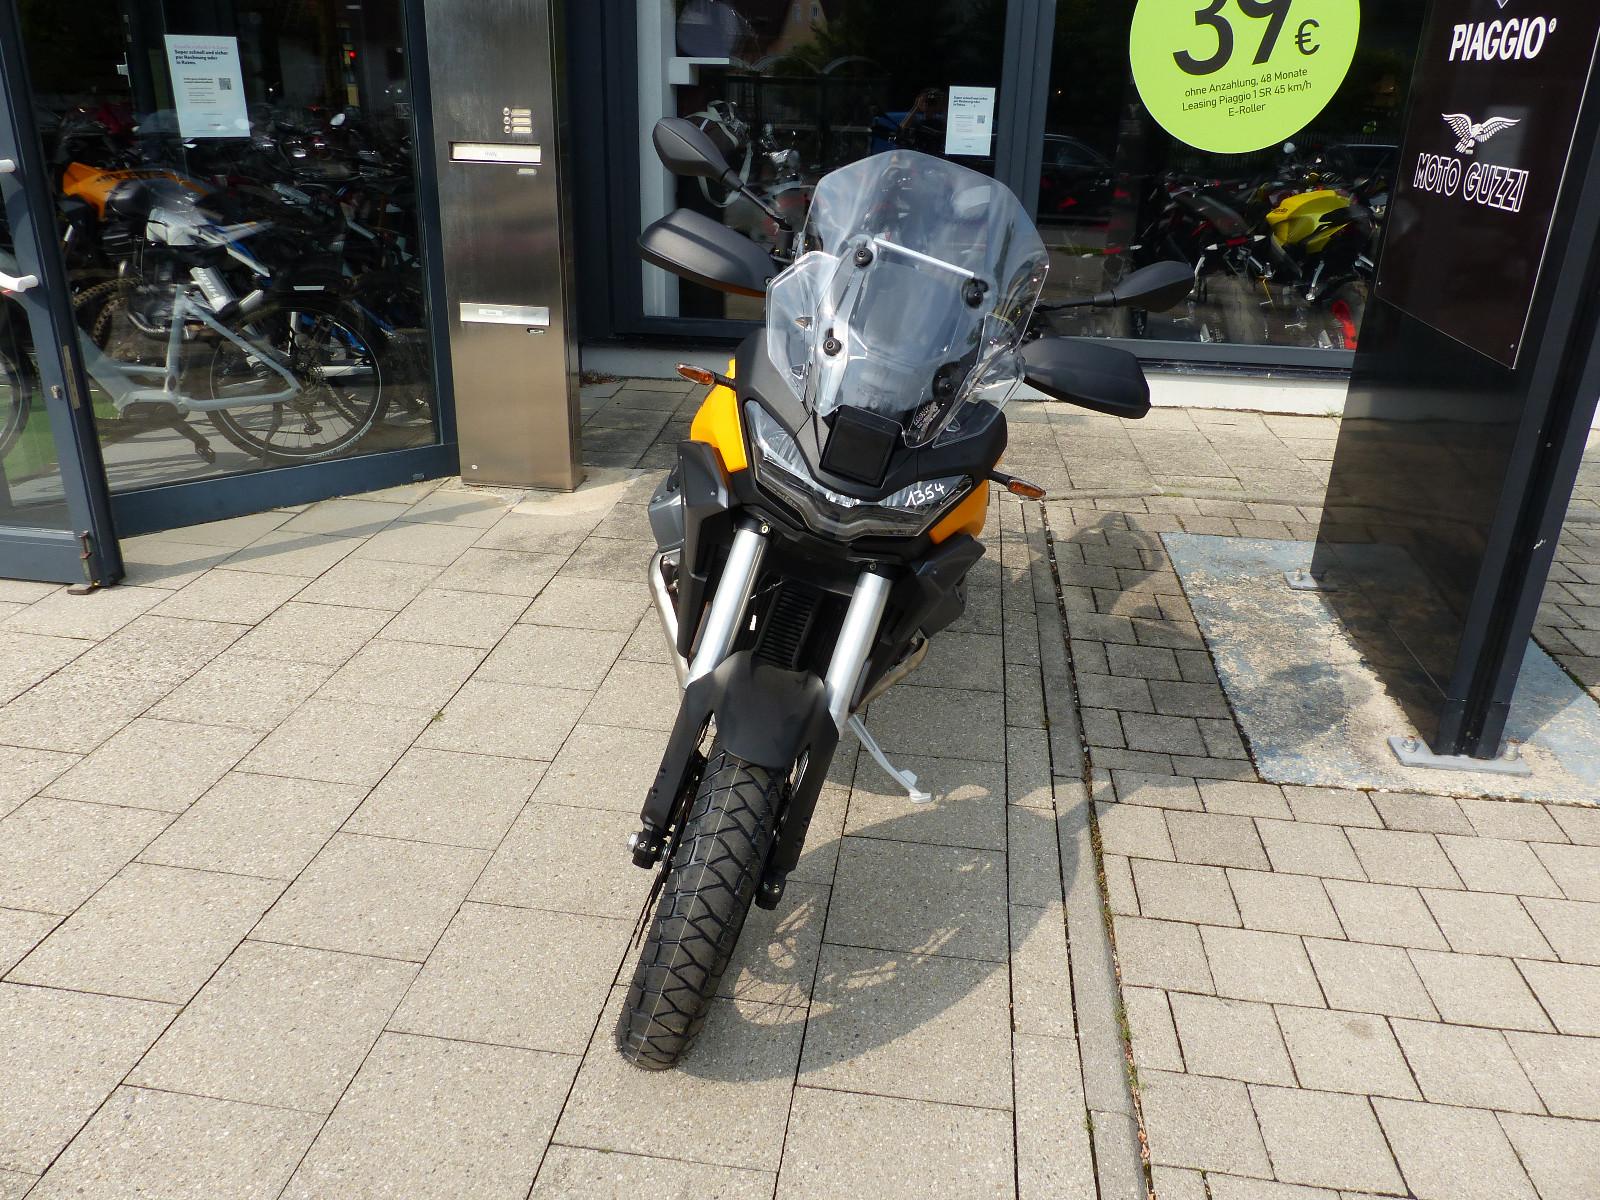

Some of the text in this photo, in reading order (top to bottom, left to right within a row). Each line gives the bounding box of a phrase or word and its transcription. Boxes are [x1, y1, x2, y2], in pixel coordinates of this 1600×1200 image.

[1172, 0, 1292, 75] 39
[1182, 79, 1312, 111] Leasing Piaggio 1 SR 45 km/h
[1184, 68, 1308, 97] ohne Anzahlung, 48 Monate
[1228, 103, 1266, 116] E-Roller
[1413, 152, 1529, 212] MOTO GUZZI
[905, 483, 945, 507] 1354
